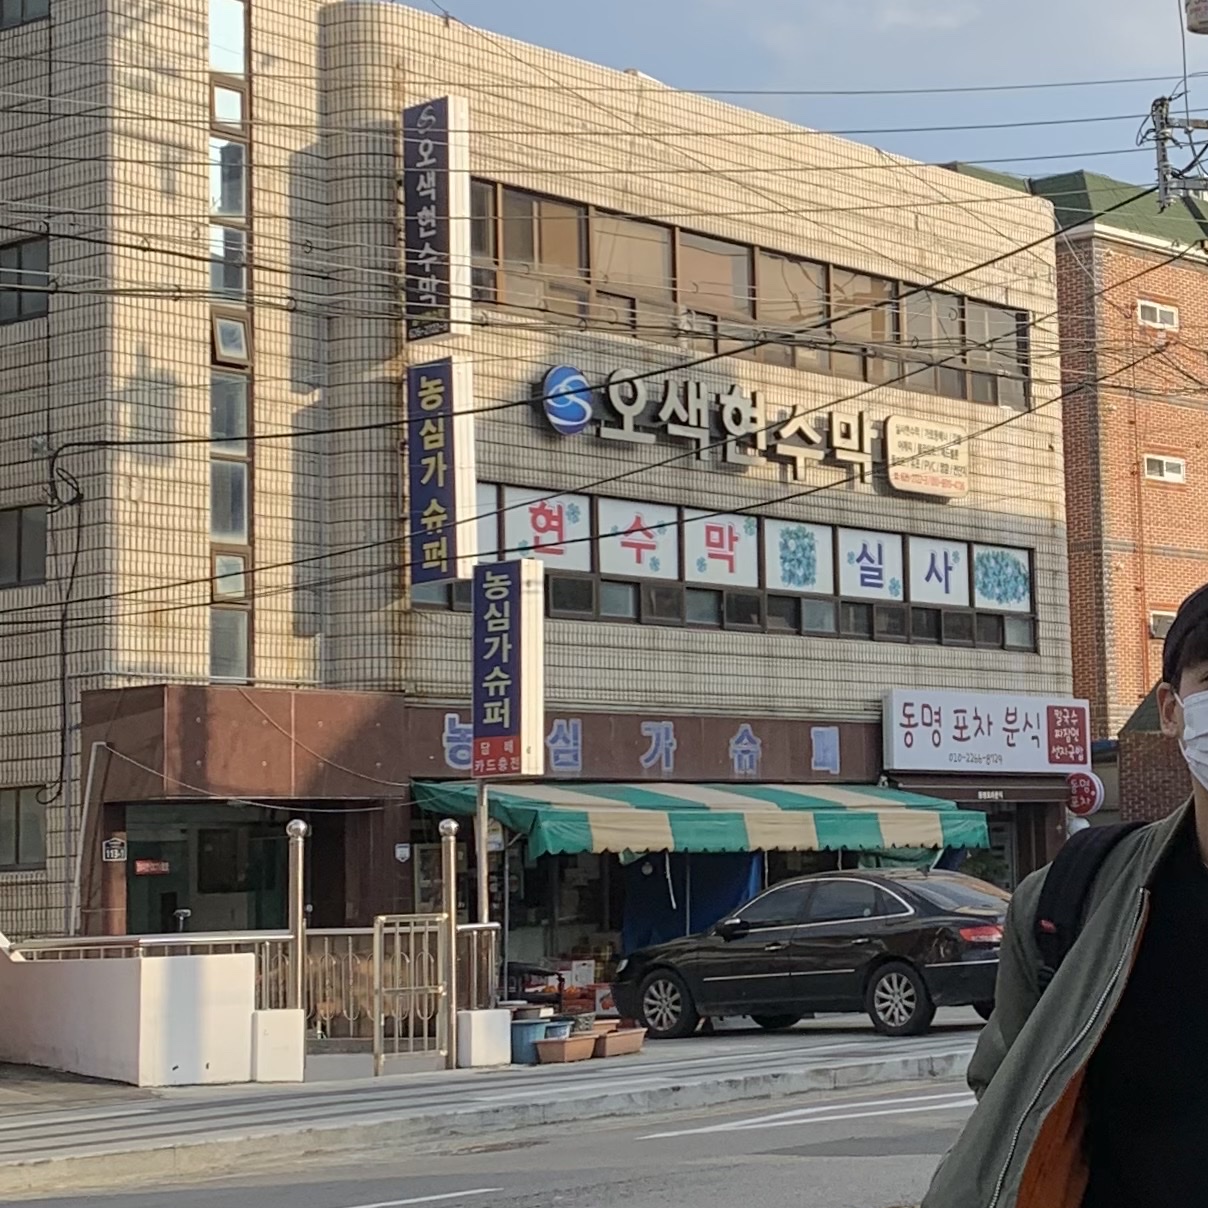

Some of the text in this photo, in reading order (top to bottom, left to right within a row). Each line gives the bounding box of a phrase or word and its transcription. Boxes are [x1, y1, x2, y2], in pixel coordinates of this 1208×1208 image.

[415, 138, 438, 306] 오색현수막
[598, 367, 879, 485] 오색현수막
[528, 501, 953, 595] 현수막 실사
[482, 571, 513, 730] 농심가슈퍼
[899, 702, 1042, 749] 동명 포차 분식
